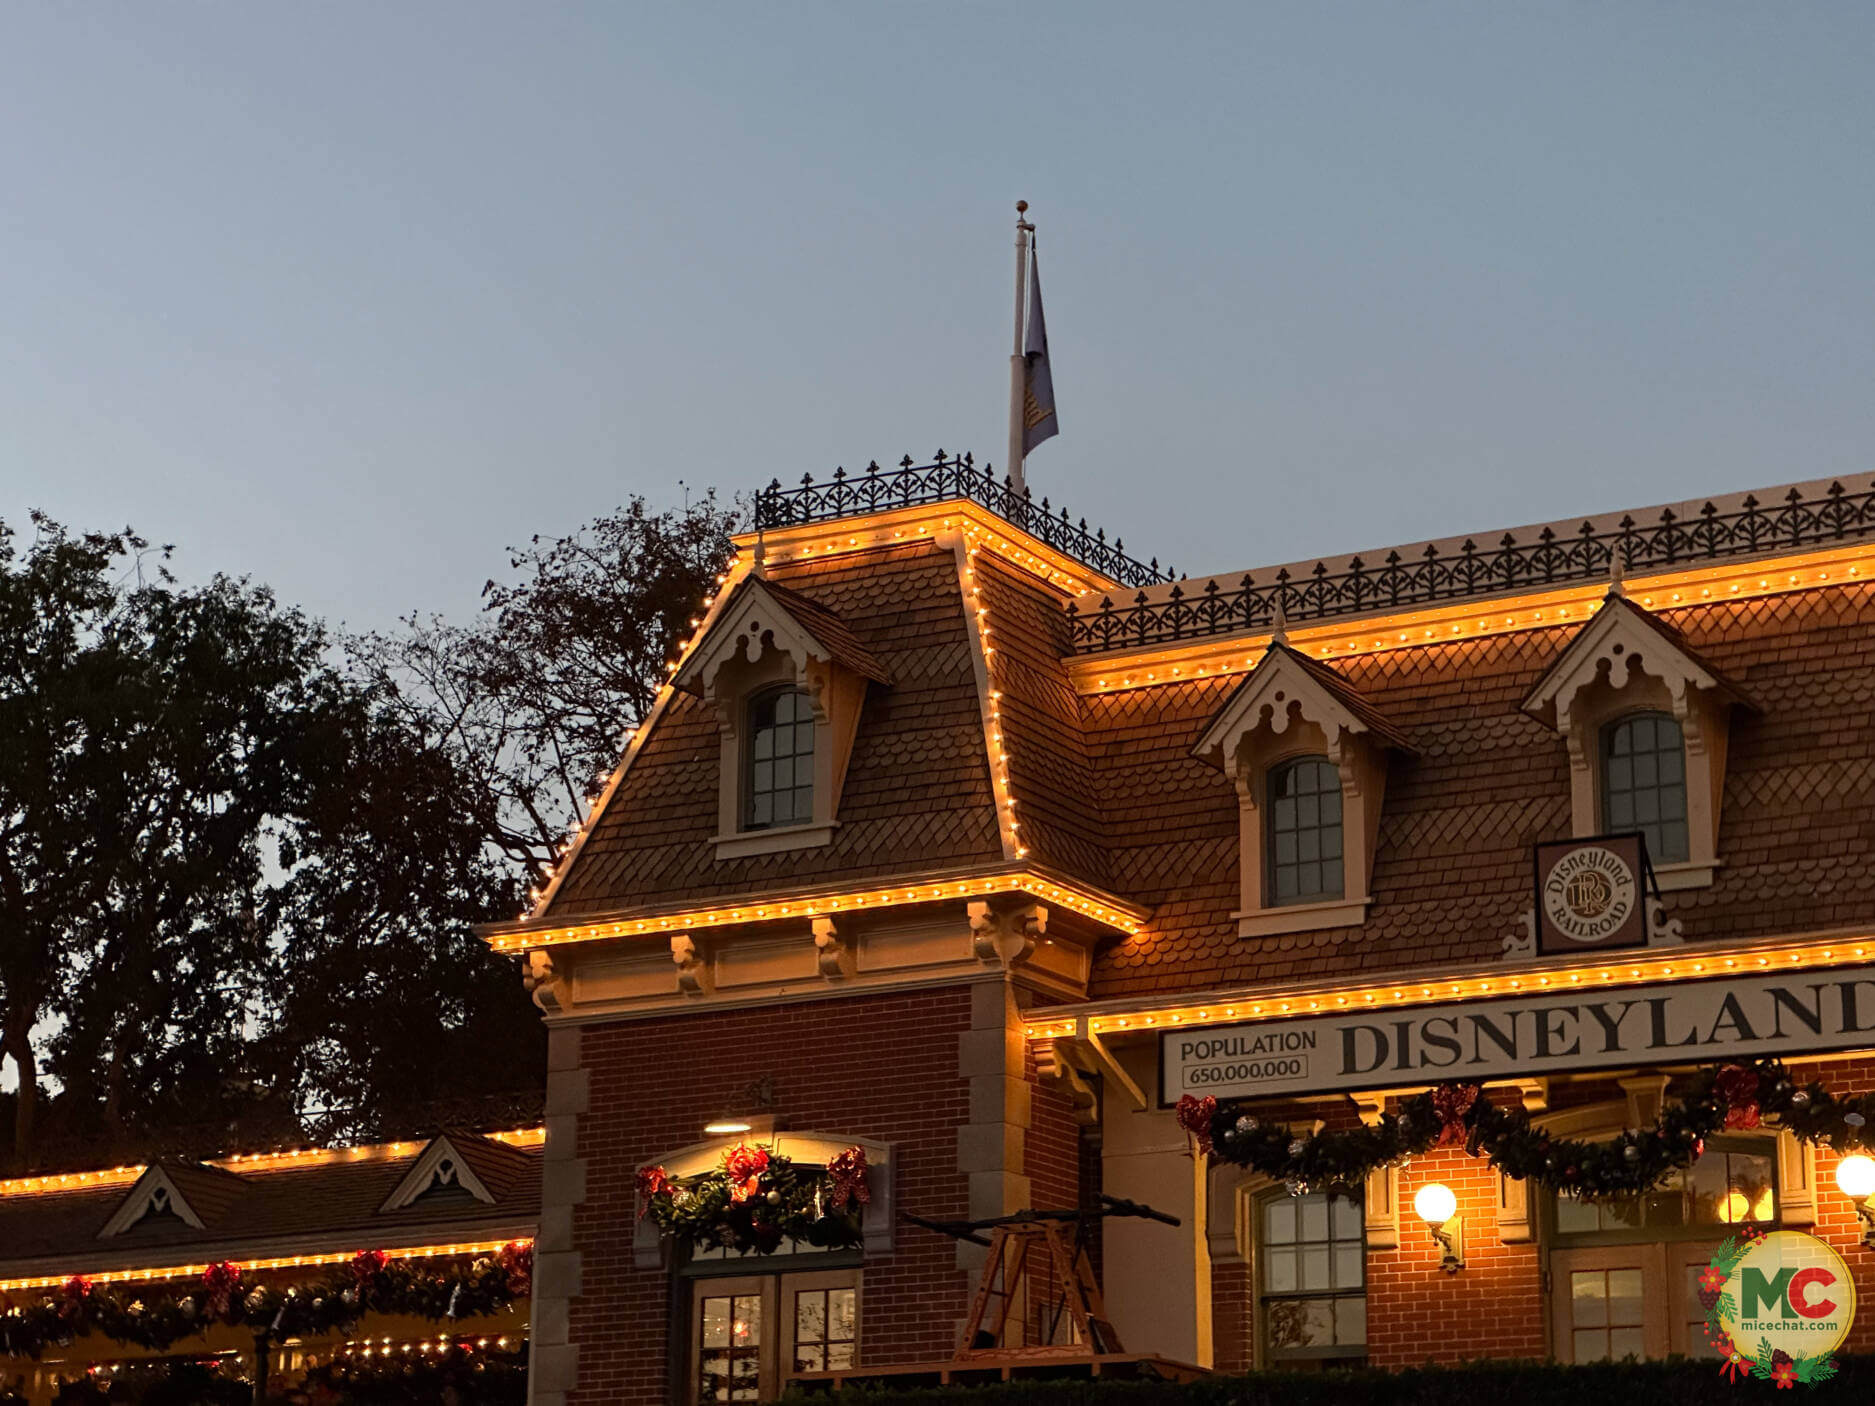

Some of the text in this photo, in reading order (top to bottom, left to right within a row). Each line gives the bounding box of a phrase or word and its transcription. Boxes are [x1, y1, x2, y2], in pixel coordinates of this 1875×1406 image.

[1546, 850, 1633, 894] Disneyland
[1552, 901, 1628, 937] RAILROAD
[1181, 1030, 1317, 1061] POPULATION
[1335, 980, 1875, 1076] DISNEYLAND
[1190, 1059, 1301, 1084] 650,000,000
